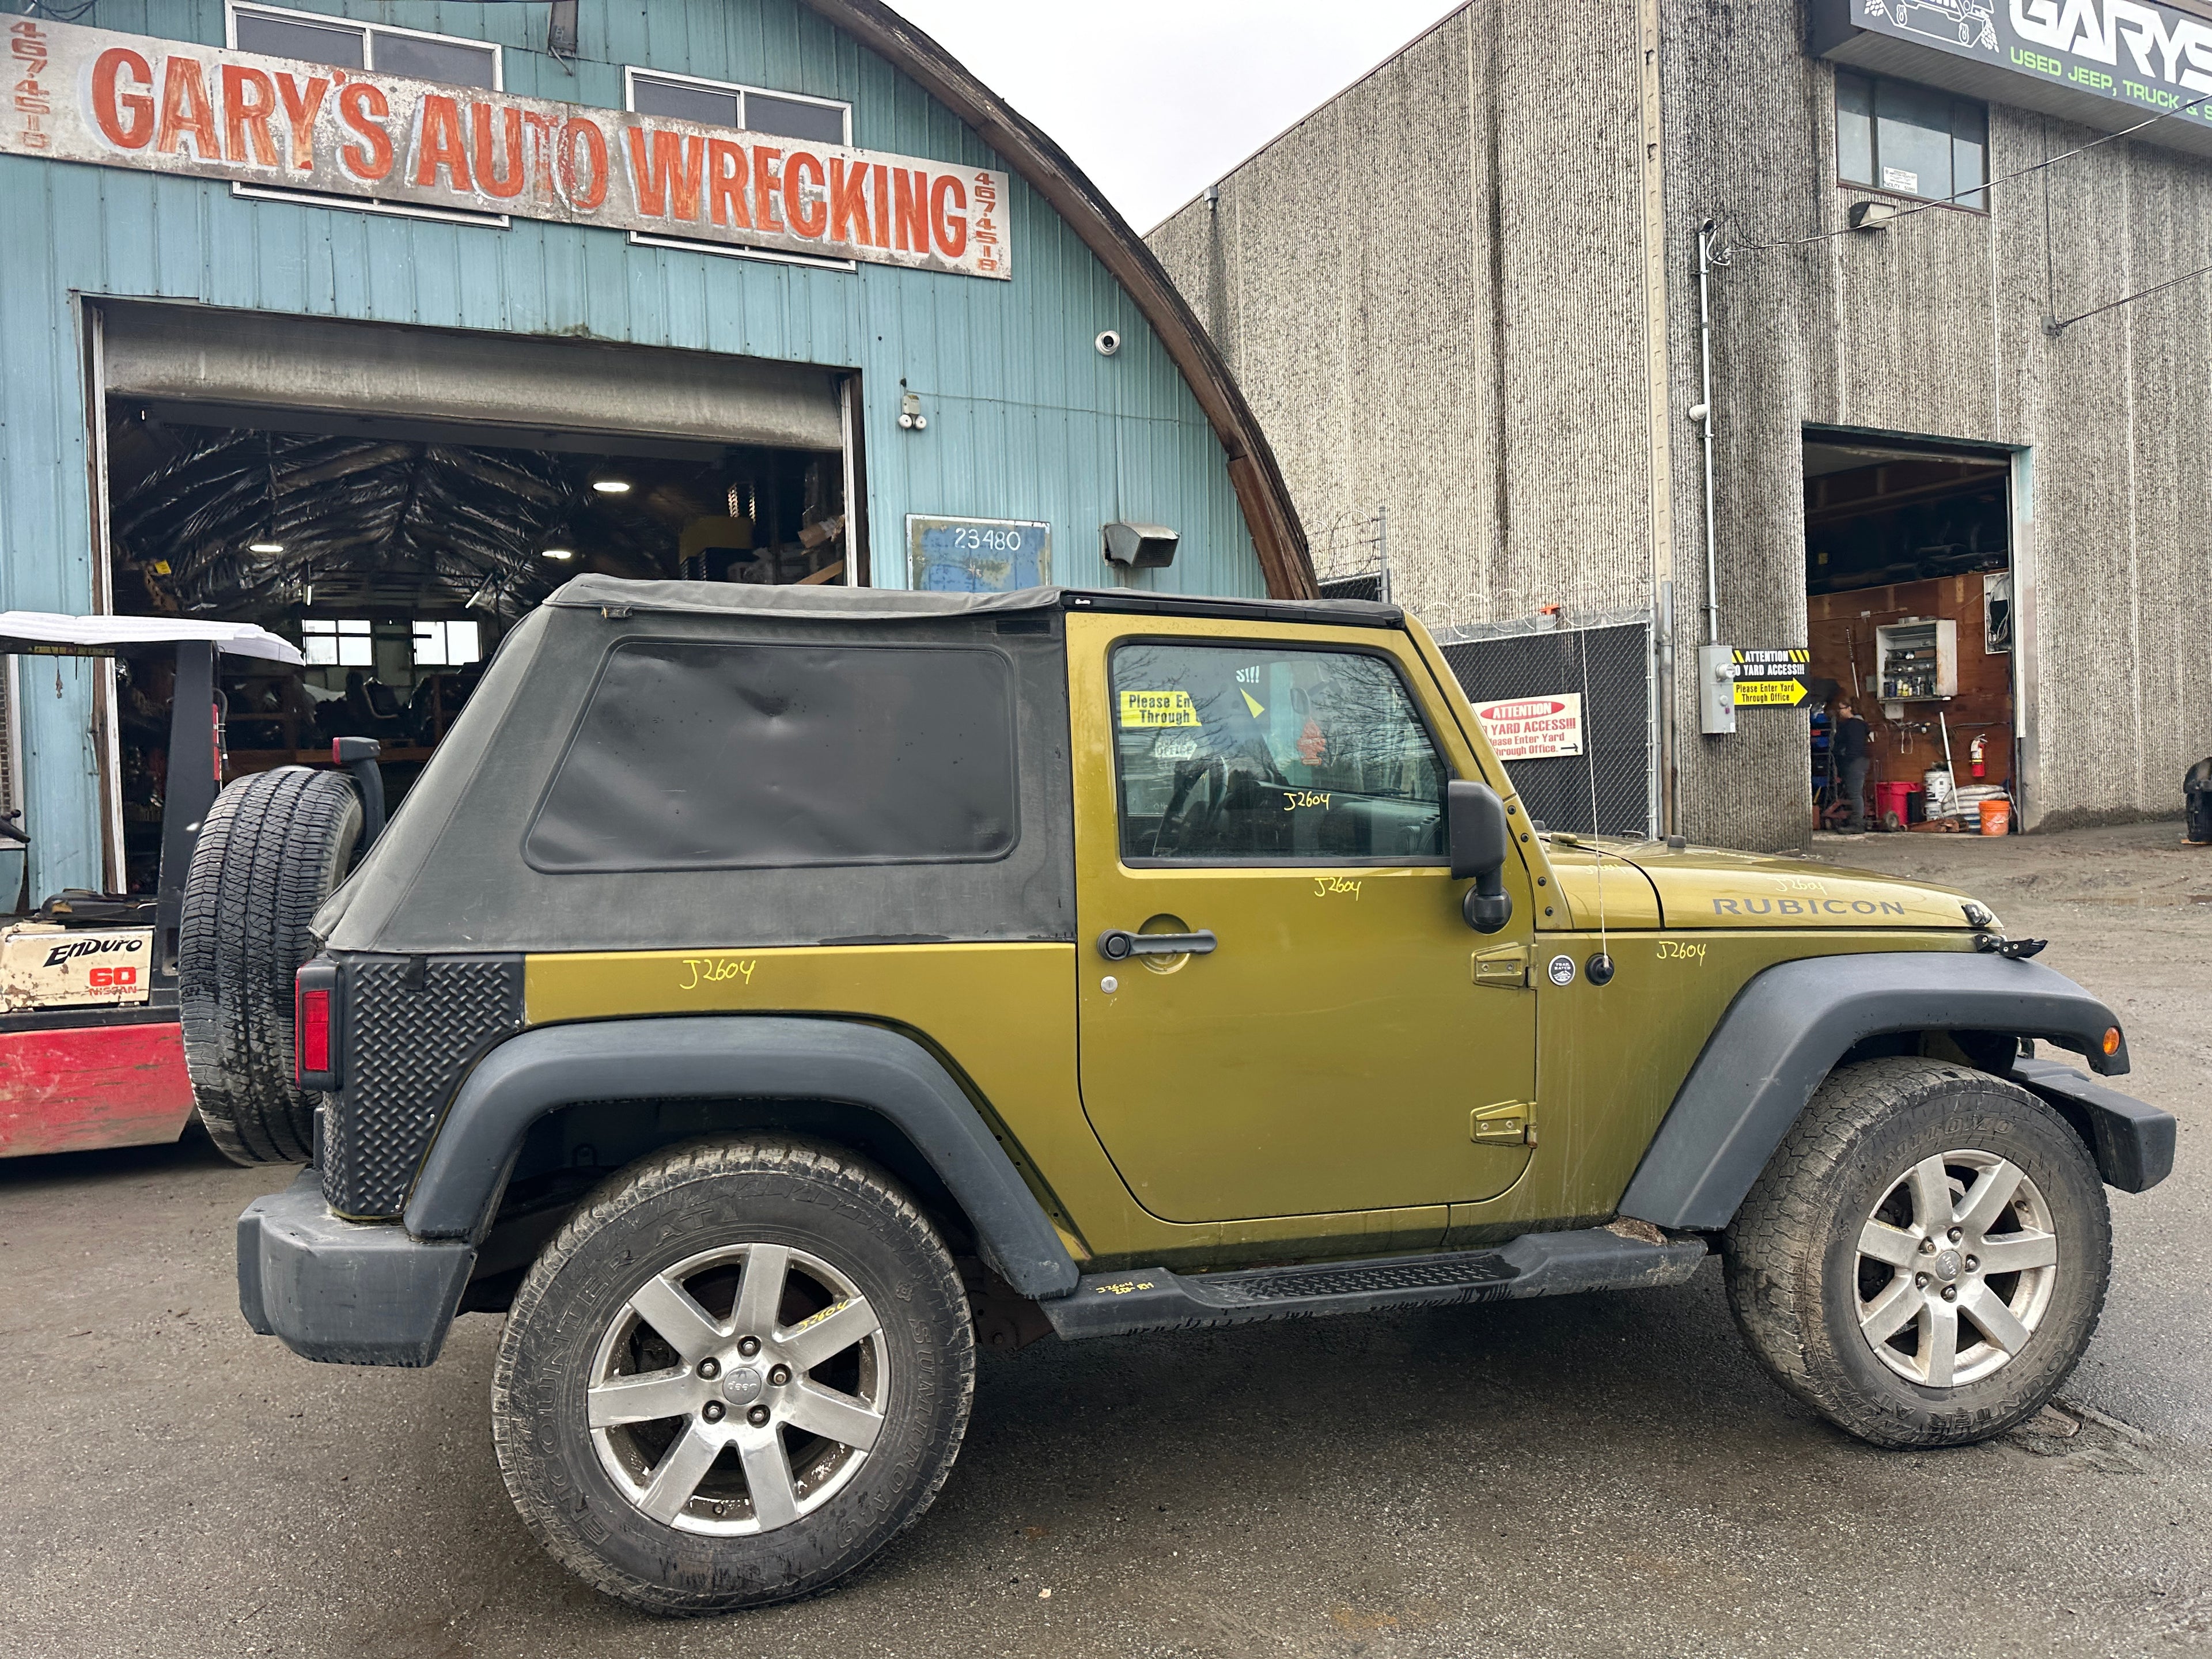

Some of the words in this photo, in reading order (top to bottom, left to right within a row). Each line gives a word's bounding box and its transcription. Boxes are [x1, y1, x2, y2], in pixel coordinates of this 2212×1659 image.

[2010, 47, 2062, 76] USED
[2068, 66, 2118, 97] JEEP,
[2123, 79, 2180, 109] TRUCK
[92, 48, 394, 180] GARY'S
[416, 94, 608, 210] AUTO
[626, 125, 968, 258] WRECKING
[954, 528, 1021, 551] 23480
[1745, 650, 1789, 662] ATTENTION
[1743, 664, 1764, 676] YARD
[1767, 664, 1805, 675] ACCESS!!!
[1736, 684, 1758, 693] Please
[1760, 684, 1778, 692] Enter
[1780, 683, 1794, 692] Yard
[1129, 695, 1170, 708] Please
[1742, 694, 1767, 703] Through
[1771, 693, 1790, 702] Office
[1139, 710, 1190, 725] Through
[1493, 702, 1551, 719] ATTENTION
[1491, 722, 1520, 736] YARD
[1524, 718, 1576, 733] ACCESS!!!
[1490, 737, 1512, 746] lease
[1514, 735, 1539, 744] Enter
[1541, 732, 1565, 742] Yard
[1495, 746, 1527, 757] hrough
[1283, 791, 1331, 811] J2604
[1314, 876, 1362, 902] J2604
[1713, 899, 1906, 915] RUBICON
[1656, 941, 1706, 967] J2604
[89, 967, 137, 987] 60
[679, 959, 756, 990] J2604
[89, 986, 137, 996] NISSAN
[796, 1299, 849, 1334] J2604
